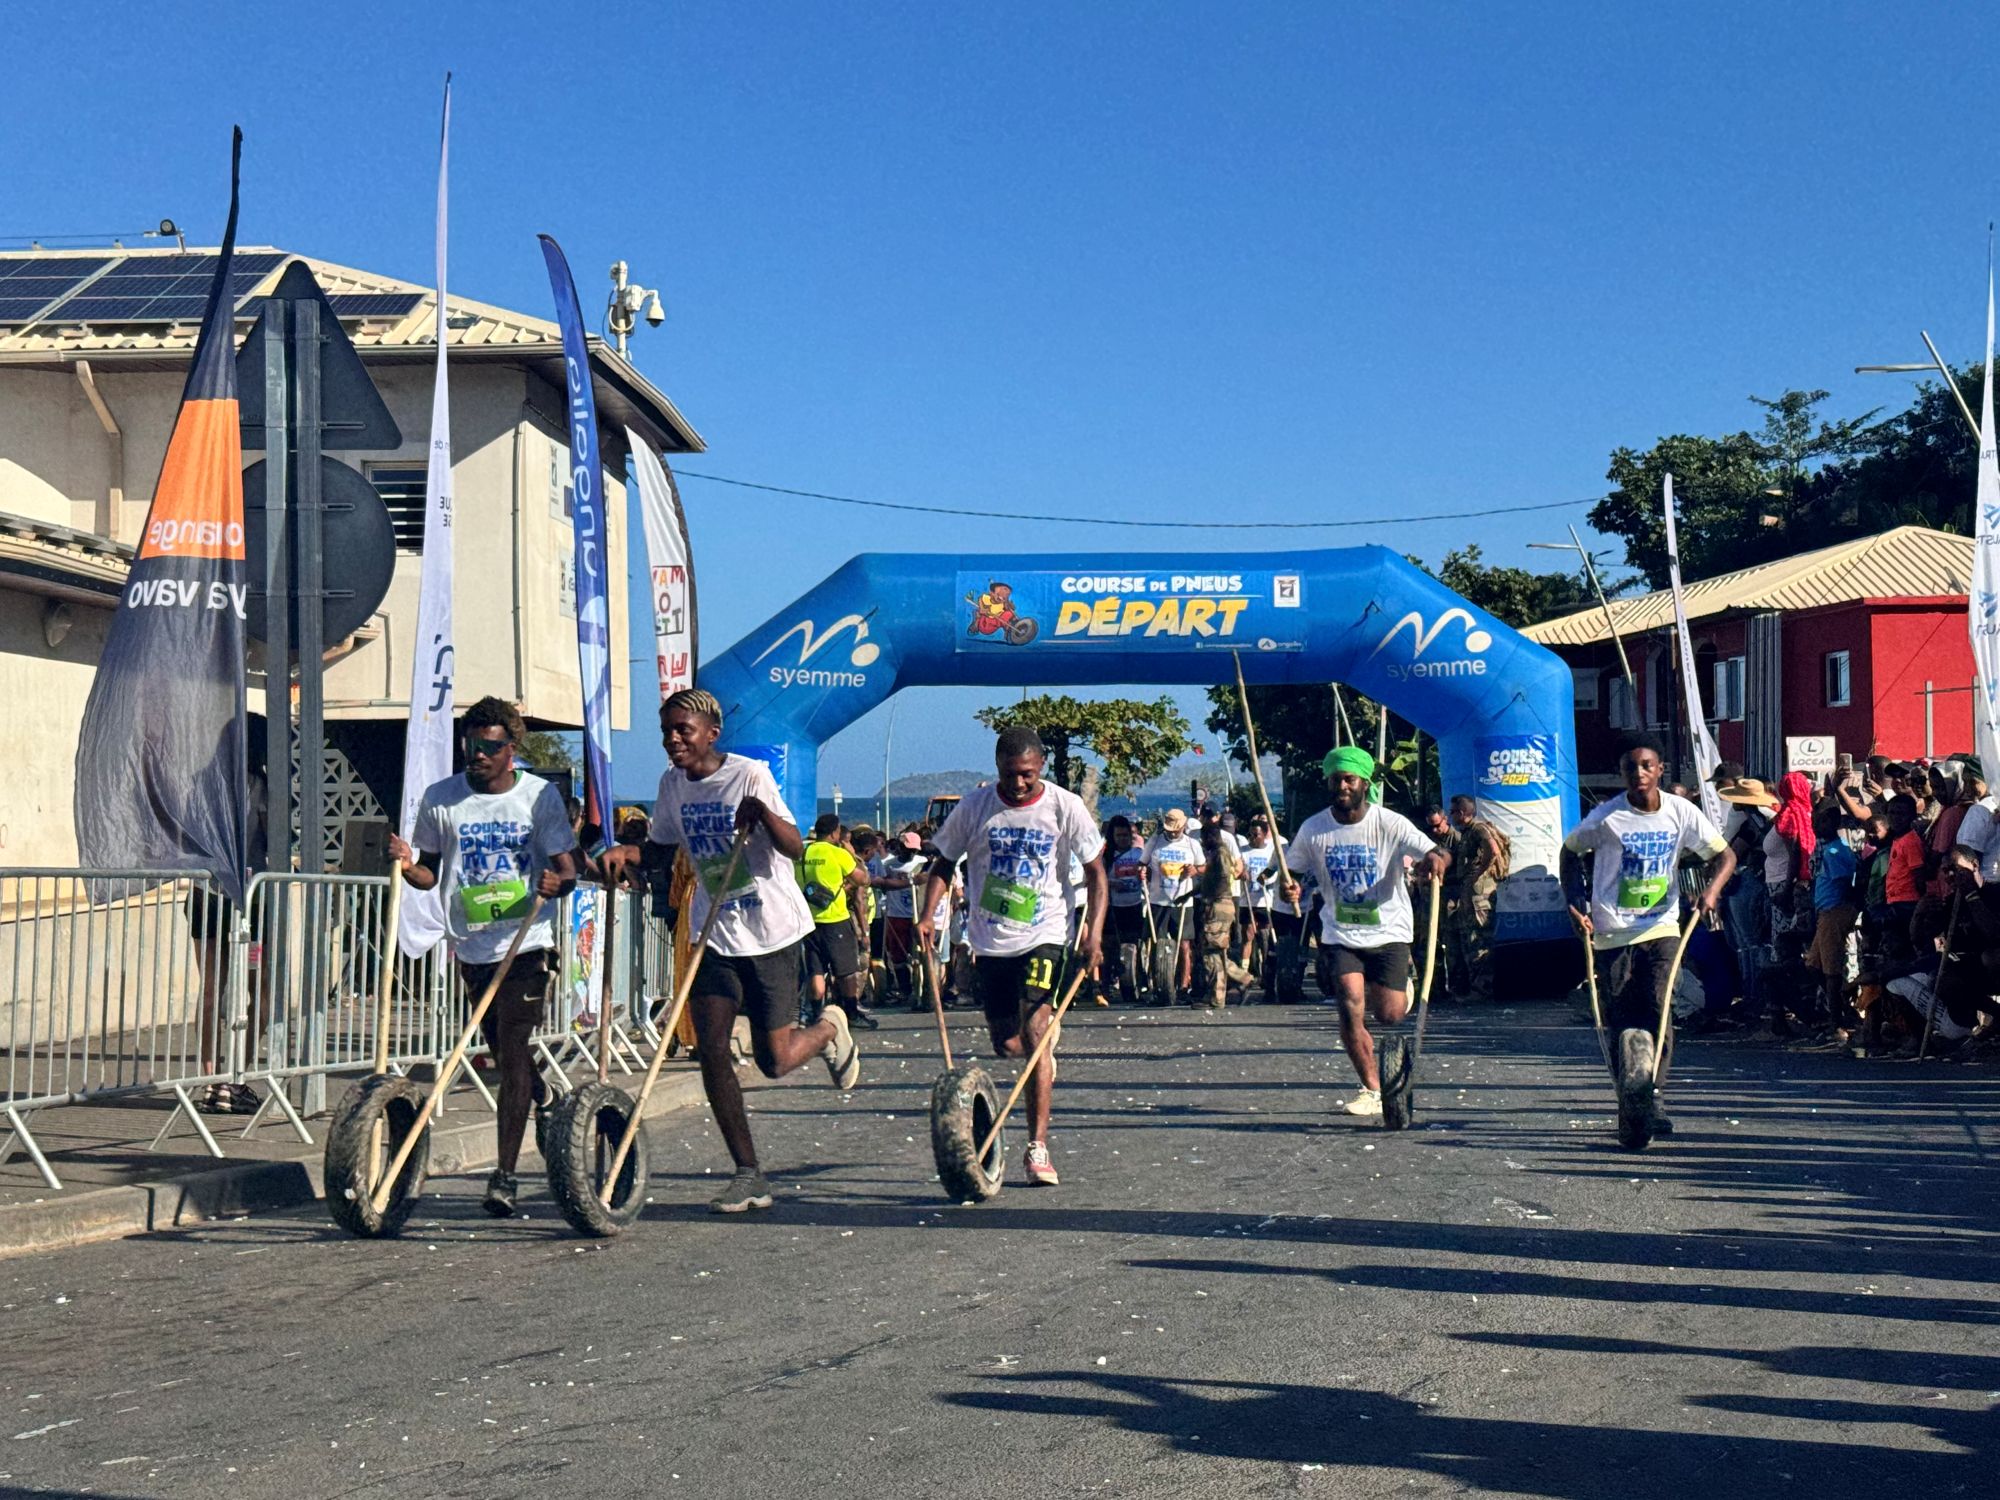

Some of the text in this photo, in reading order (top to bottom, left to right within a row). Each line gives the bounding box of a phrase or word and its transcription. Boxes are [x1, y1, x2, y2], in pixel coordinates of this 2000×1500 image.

[1061, 575, 1243, 593] COURSE DE PNEUS
[1054, 596, 1249, 638] DÉPART
[769, 666, 866, 689] syemme
[1386, 659, 1487, 682] syemme
[1807, 741, 1817, 752] L
[1489, 748, 1545, 766] COURSE
[1487, 763, 1548, 779] DE PNEUS
[1501, 773, 1530, 786] 2026
[681, 802, 723, 816] COURSE
[458, 821, 519, 836] COURSE
[682, 815, 735, 834] PNEUS
[988, 826, 1043, 840] COURSE
[1621, 831, 1669, 842] COURSE
[459, 834, 531, 852] PNEUS
[988, 840, 1053, 857] PNEUS
[1325, 844, 1367, 855] COURSE
[1622, 842, 1675, 857] PNEUS
[461, 851, 532, 871] MAY
[1325, 854, 1377, 871] PNEUS
[1000, 900, 1010, 915] 6
[1640, 894, 1650, 907] 6
[490, 903, 502, 919] 6
[1026, 957, 1053, 990] 11
